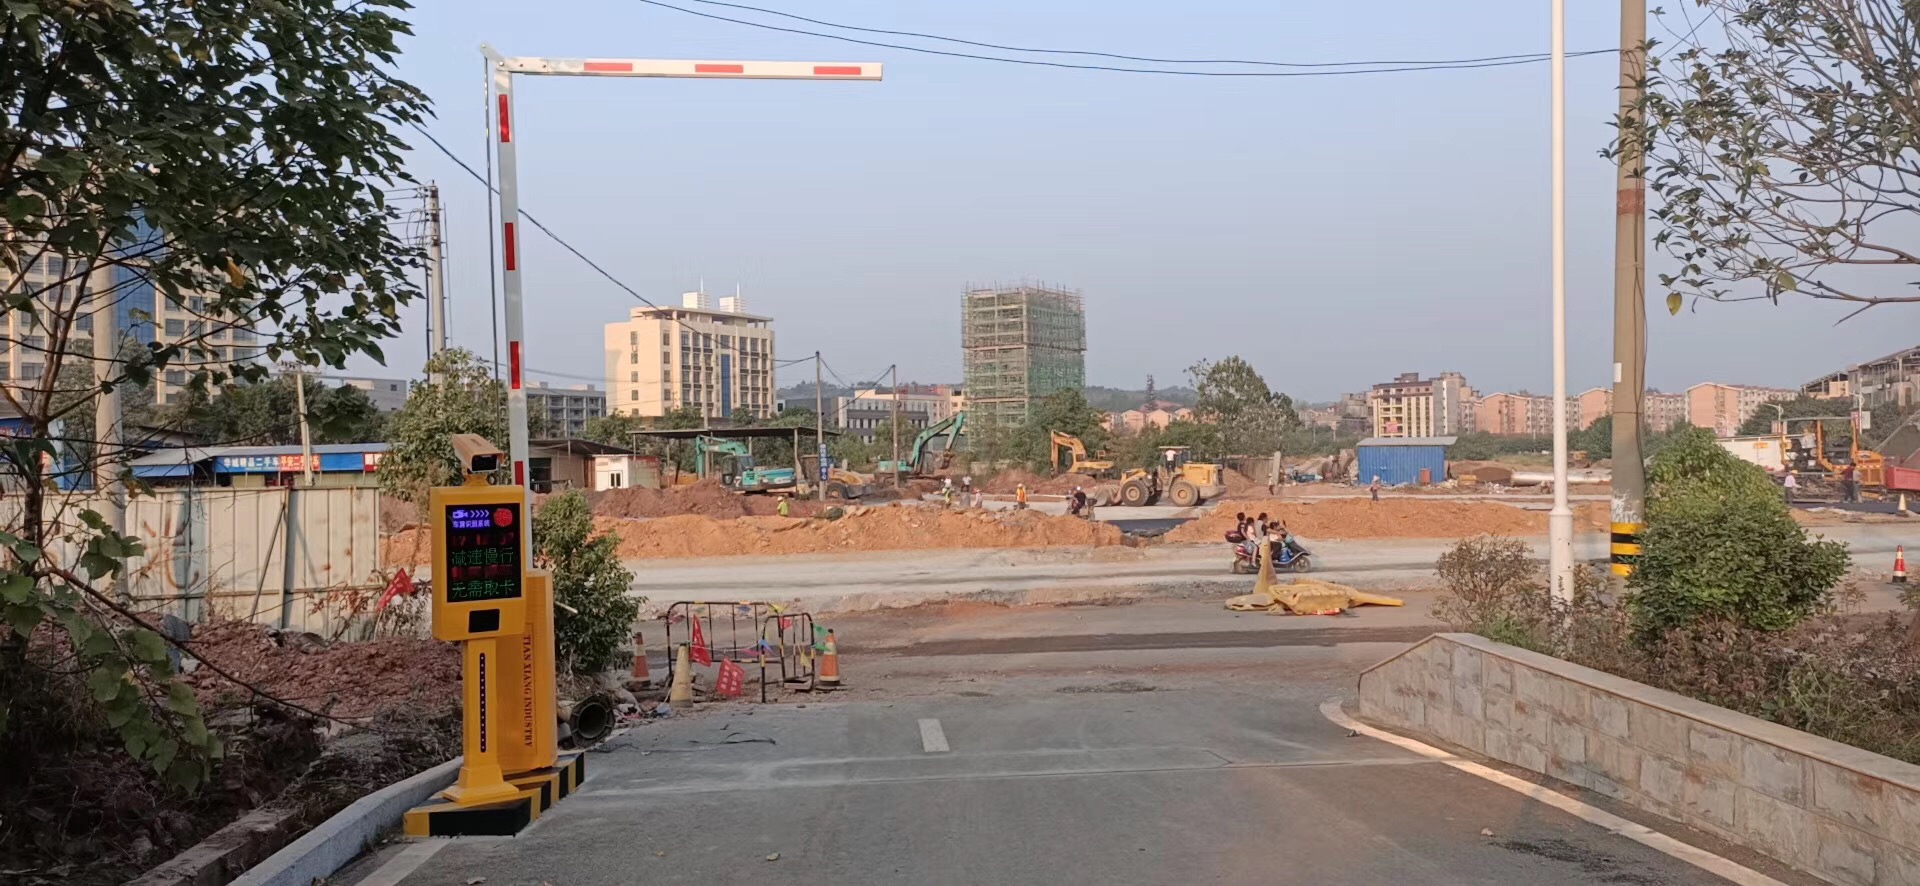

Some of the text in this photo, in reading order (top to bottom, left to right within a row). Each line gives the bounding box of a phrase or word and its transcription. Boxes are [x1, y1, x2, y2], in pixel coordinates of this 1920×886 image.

[451, 547, 514, 566] 减速慢行
[451, 579, 515, 599] 无需取卡
[522, 635, 533, 748] TIAN XIANG INDUSTRY
